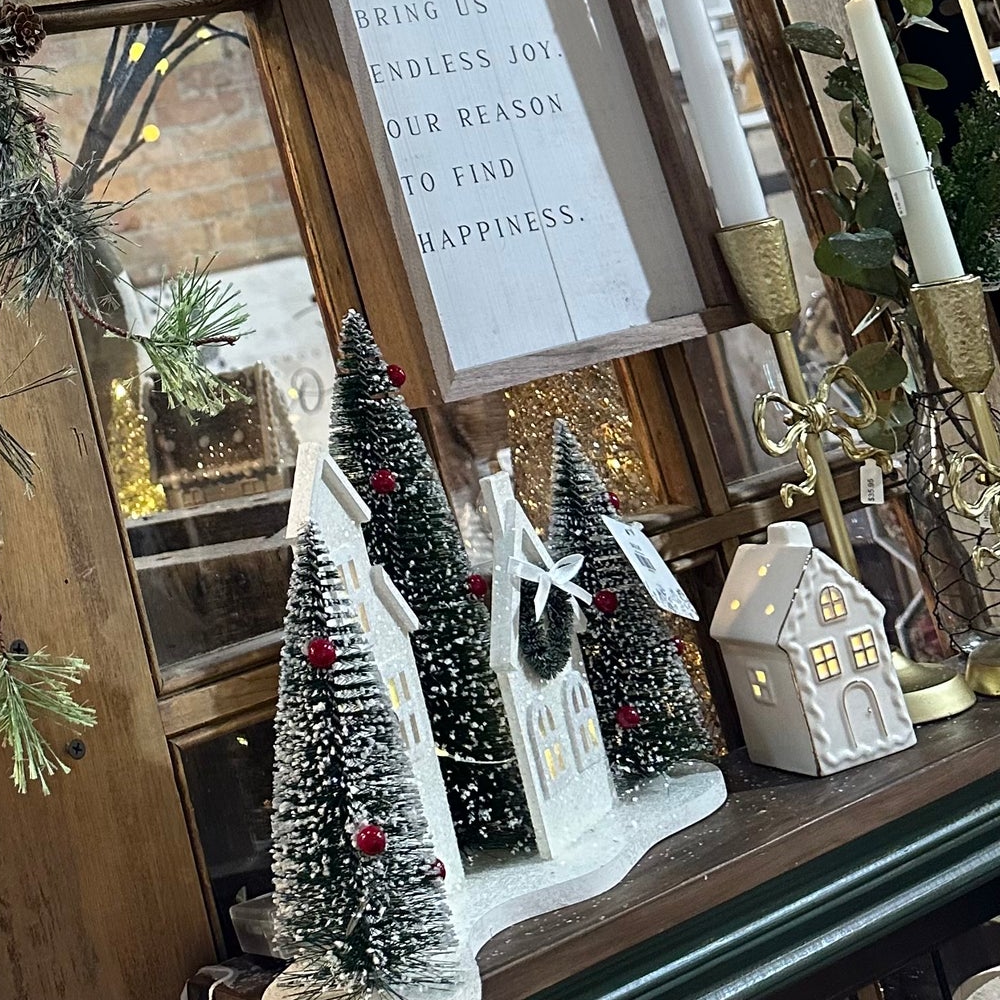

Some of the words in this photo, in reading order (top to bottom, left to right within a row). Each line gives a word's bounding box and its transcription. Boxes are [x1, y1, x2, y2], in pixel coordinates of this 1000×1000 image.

[355, 0, 439, 29] BRING
[370, 49, 492, 84] ENDLESS
[508, 40, 563, 65] JOY.
[387, 112, 442, 140] OUR
[458, 93, 563, 128] REASON
[401, 171, 436, 196] TO
[453, 157, 515, 187] FIND
[418, 204, 584, 254] HAPPINESS.
